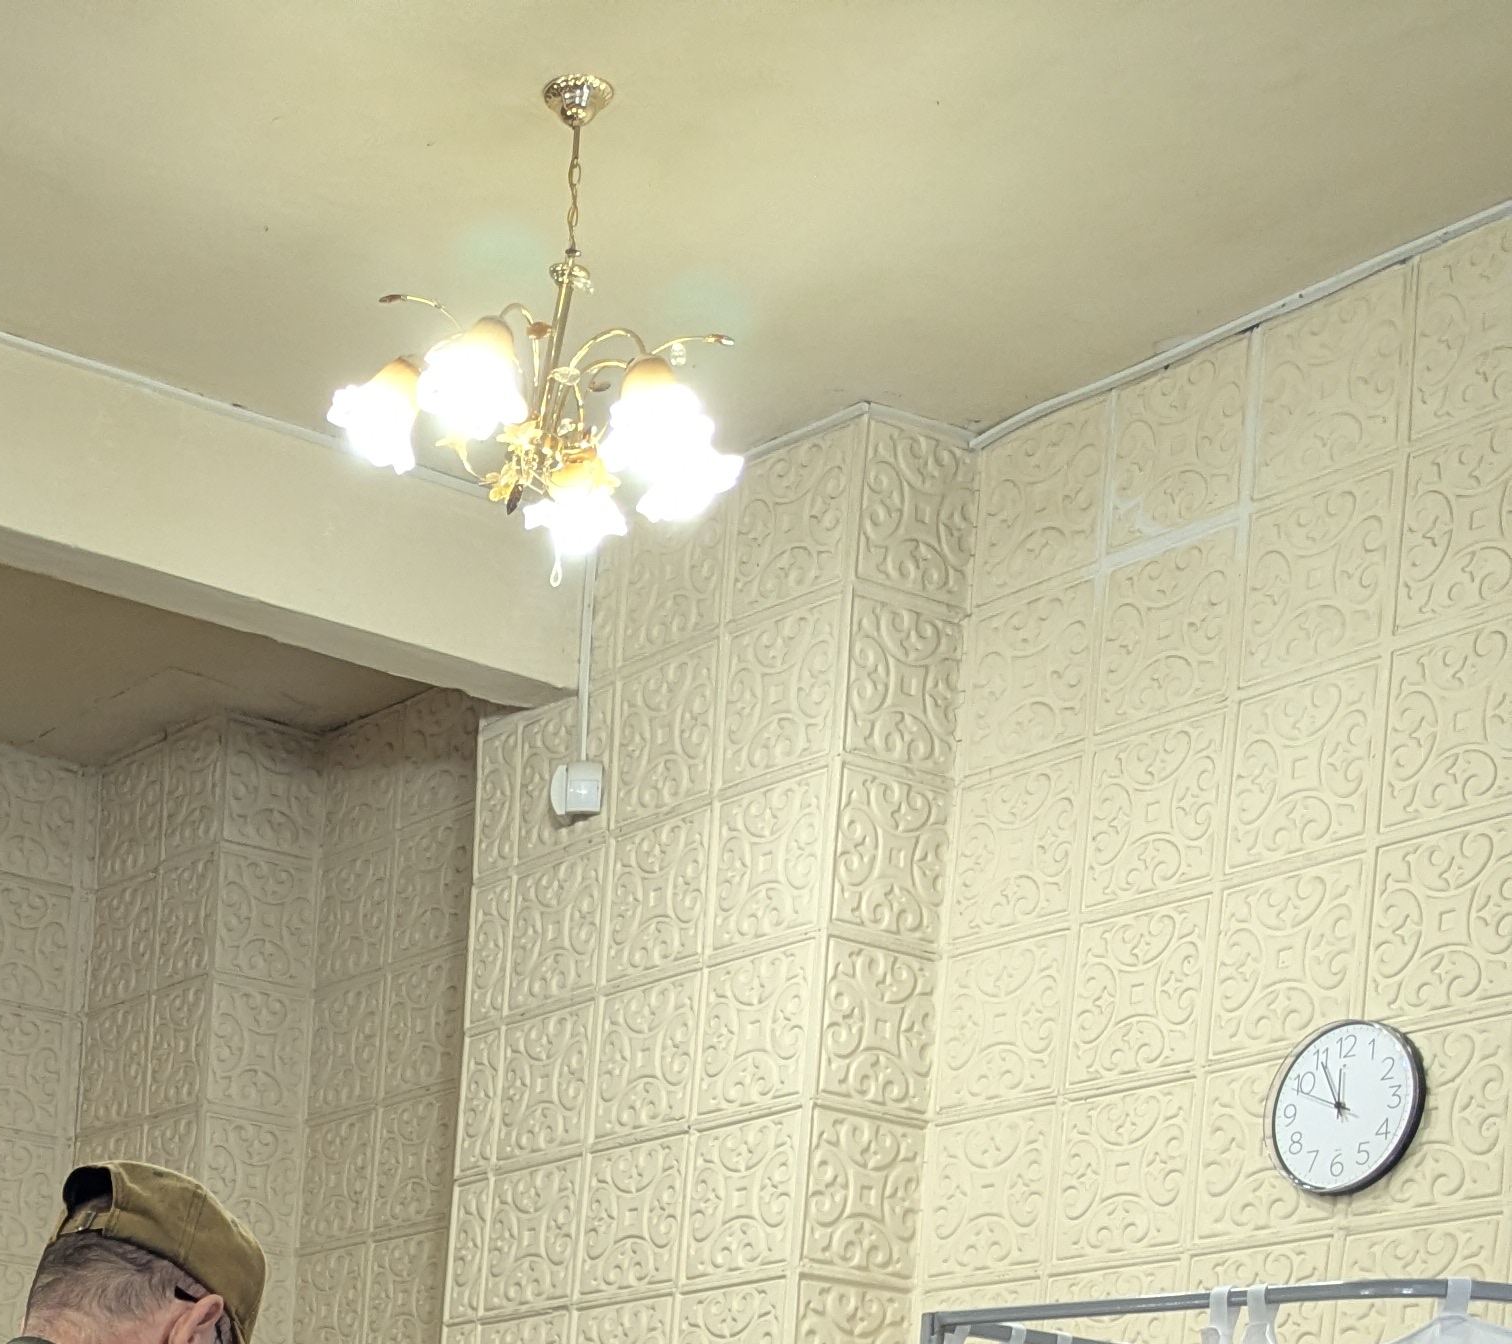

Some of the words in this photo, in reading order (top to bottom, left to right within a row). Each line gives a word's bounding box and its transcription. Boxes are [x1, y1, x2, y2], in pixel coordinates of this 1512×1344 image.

[1336, 1034, 1358, 1059] 12
[1368, 1038, 1376, 1060] 1
[1313, 1047, 1329, 1071] 11
[1380, 1056, 1395, 1081] 2
[1294, 1071, 1316, 1096] 10
[1387, 1084, 1402, 1109] 3
[1283, 1104, 1297, 1127] 9
[1375, 1118, 1391, 1140] 4
[1289, 1131, 1303, 1155] 8
[1355, 1141, 1370, 1166] 5
[1307, 1150, 1319, 1172] 7
[1330, 1153, 1344, 1177] 6
